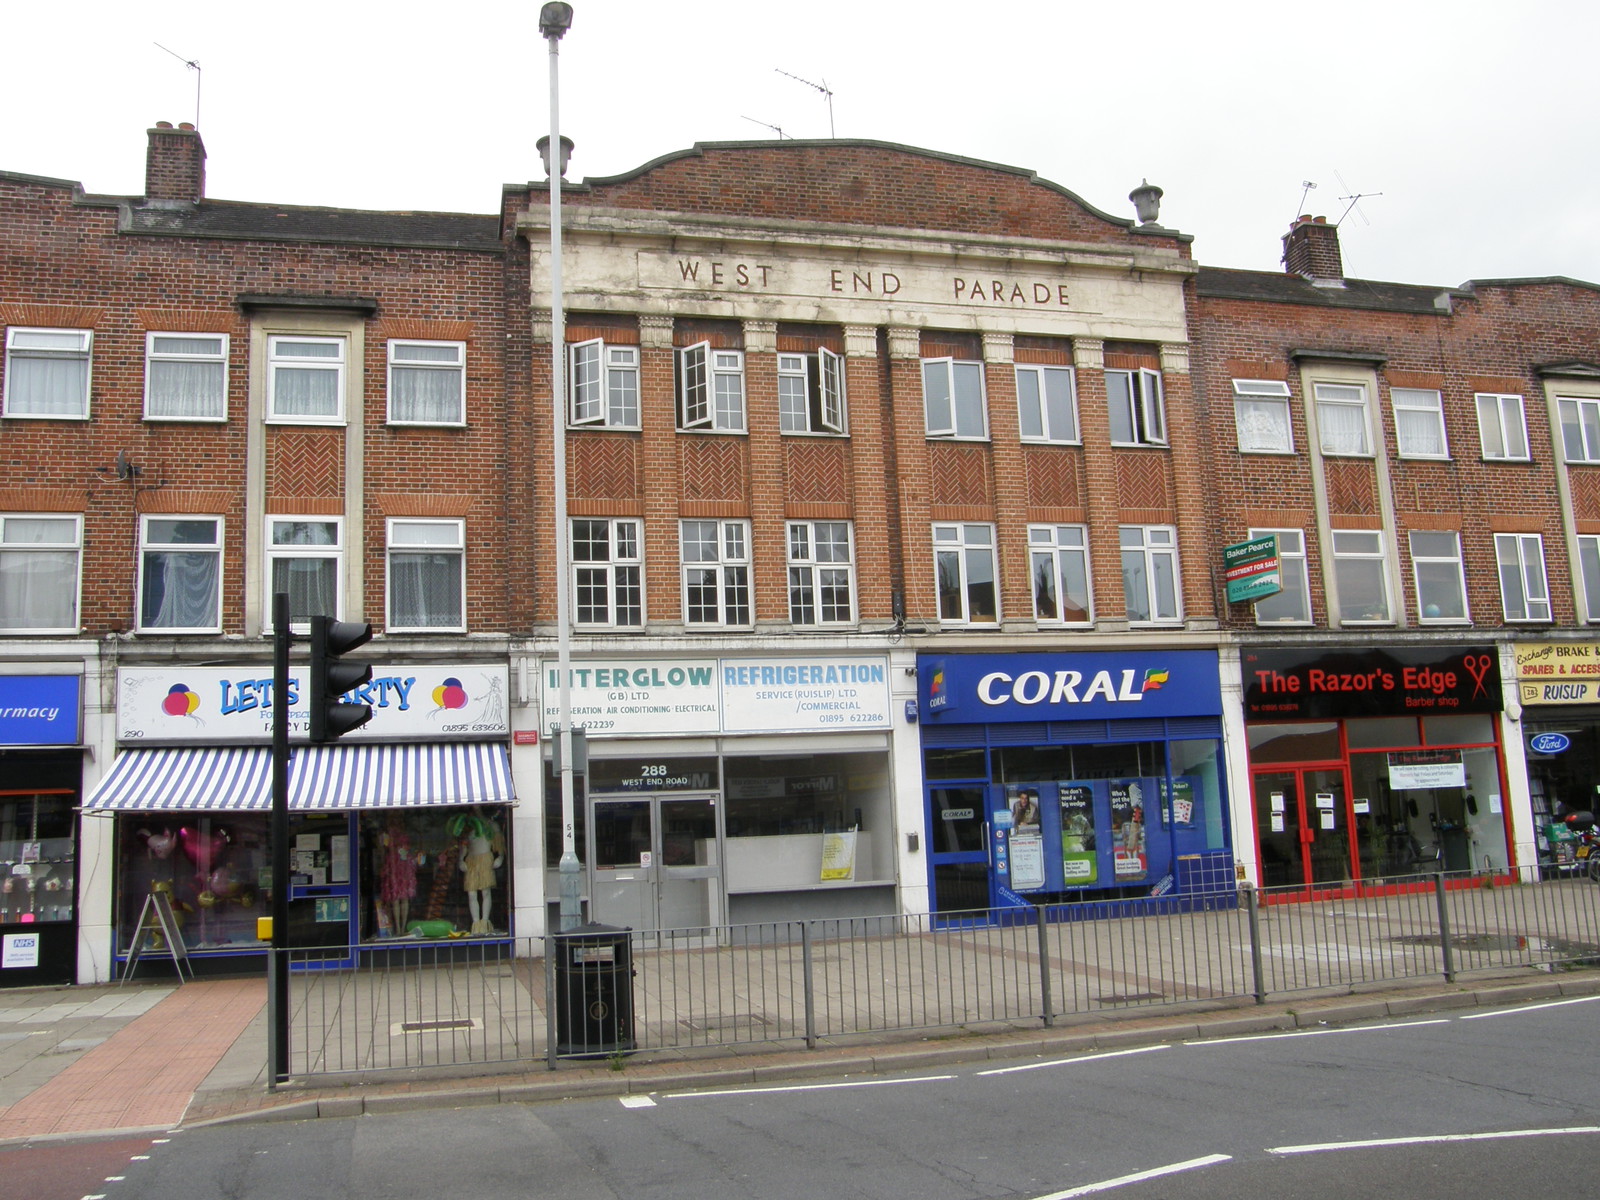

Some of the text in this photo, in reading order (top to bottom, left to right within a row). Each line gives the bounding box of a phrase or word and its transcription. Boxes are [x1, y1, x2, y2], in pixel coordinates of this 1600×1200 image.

[678, 260, 1069, 306] WEST END PARADE
[1226, 541, 1274, 558] Baker Pearce
[1265, 560, 1278, 568] SALE
[1517, 646, 1553, 665] Exchange
[1556, 646, 1590, 656] BRAKE
[1522, 665, 1554, 674] SPARES
[1559, 665, 1566, 674] &
[724, 665, 884, 686] REFRIGERATION
[1255, 667, 1457, 694] The Razor's Edge
[977, 669, 1144, 705] CORAL
[1544, 684, 1588, 700] RUISLIP
[608, 691, 628, 702] (GB)
[756, 690, 792, 700] SERVICE
[794, 689, 835, 700] (RUISLIP)
[930, 696, 946, 708] CORAL
[1406, 697, 1459, 708] Barber shop
[606, 705, 618, 714] AIR
[620, 704, 671, 714] CONDITIONING
[675, 704, 716, 713] ELECTRICAL
[820, 714, 884, 722] 01895 622286
[442, 724, 506, 732] 01895 633606
[581, 720, 614, 729] 622239
[1538, 736, 1562, 750] Ford
[642, 765, 667, 776] 288
[14, 939, 34, 948] NHS
